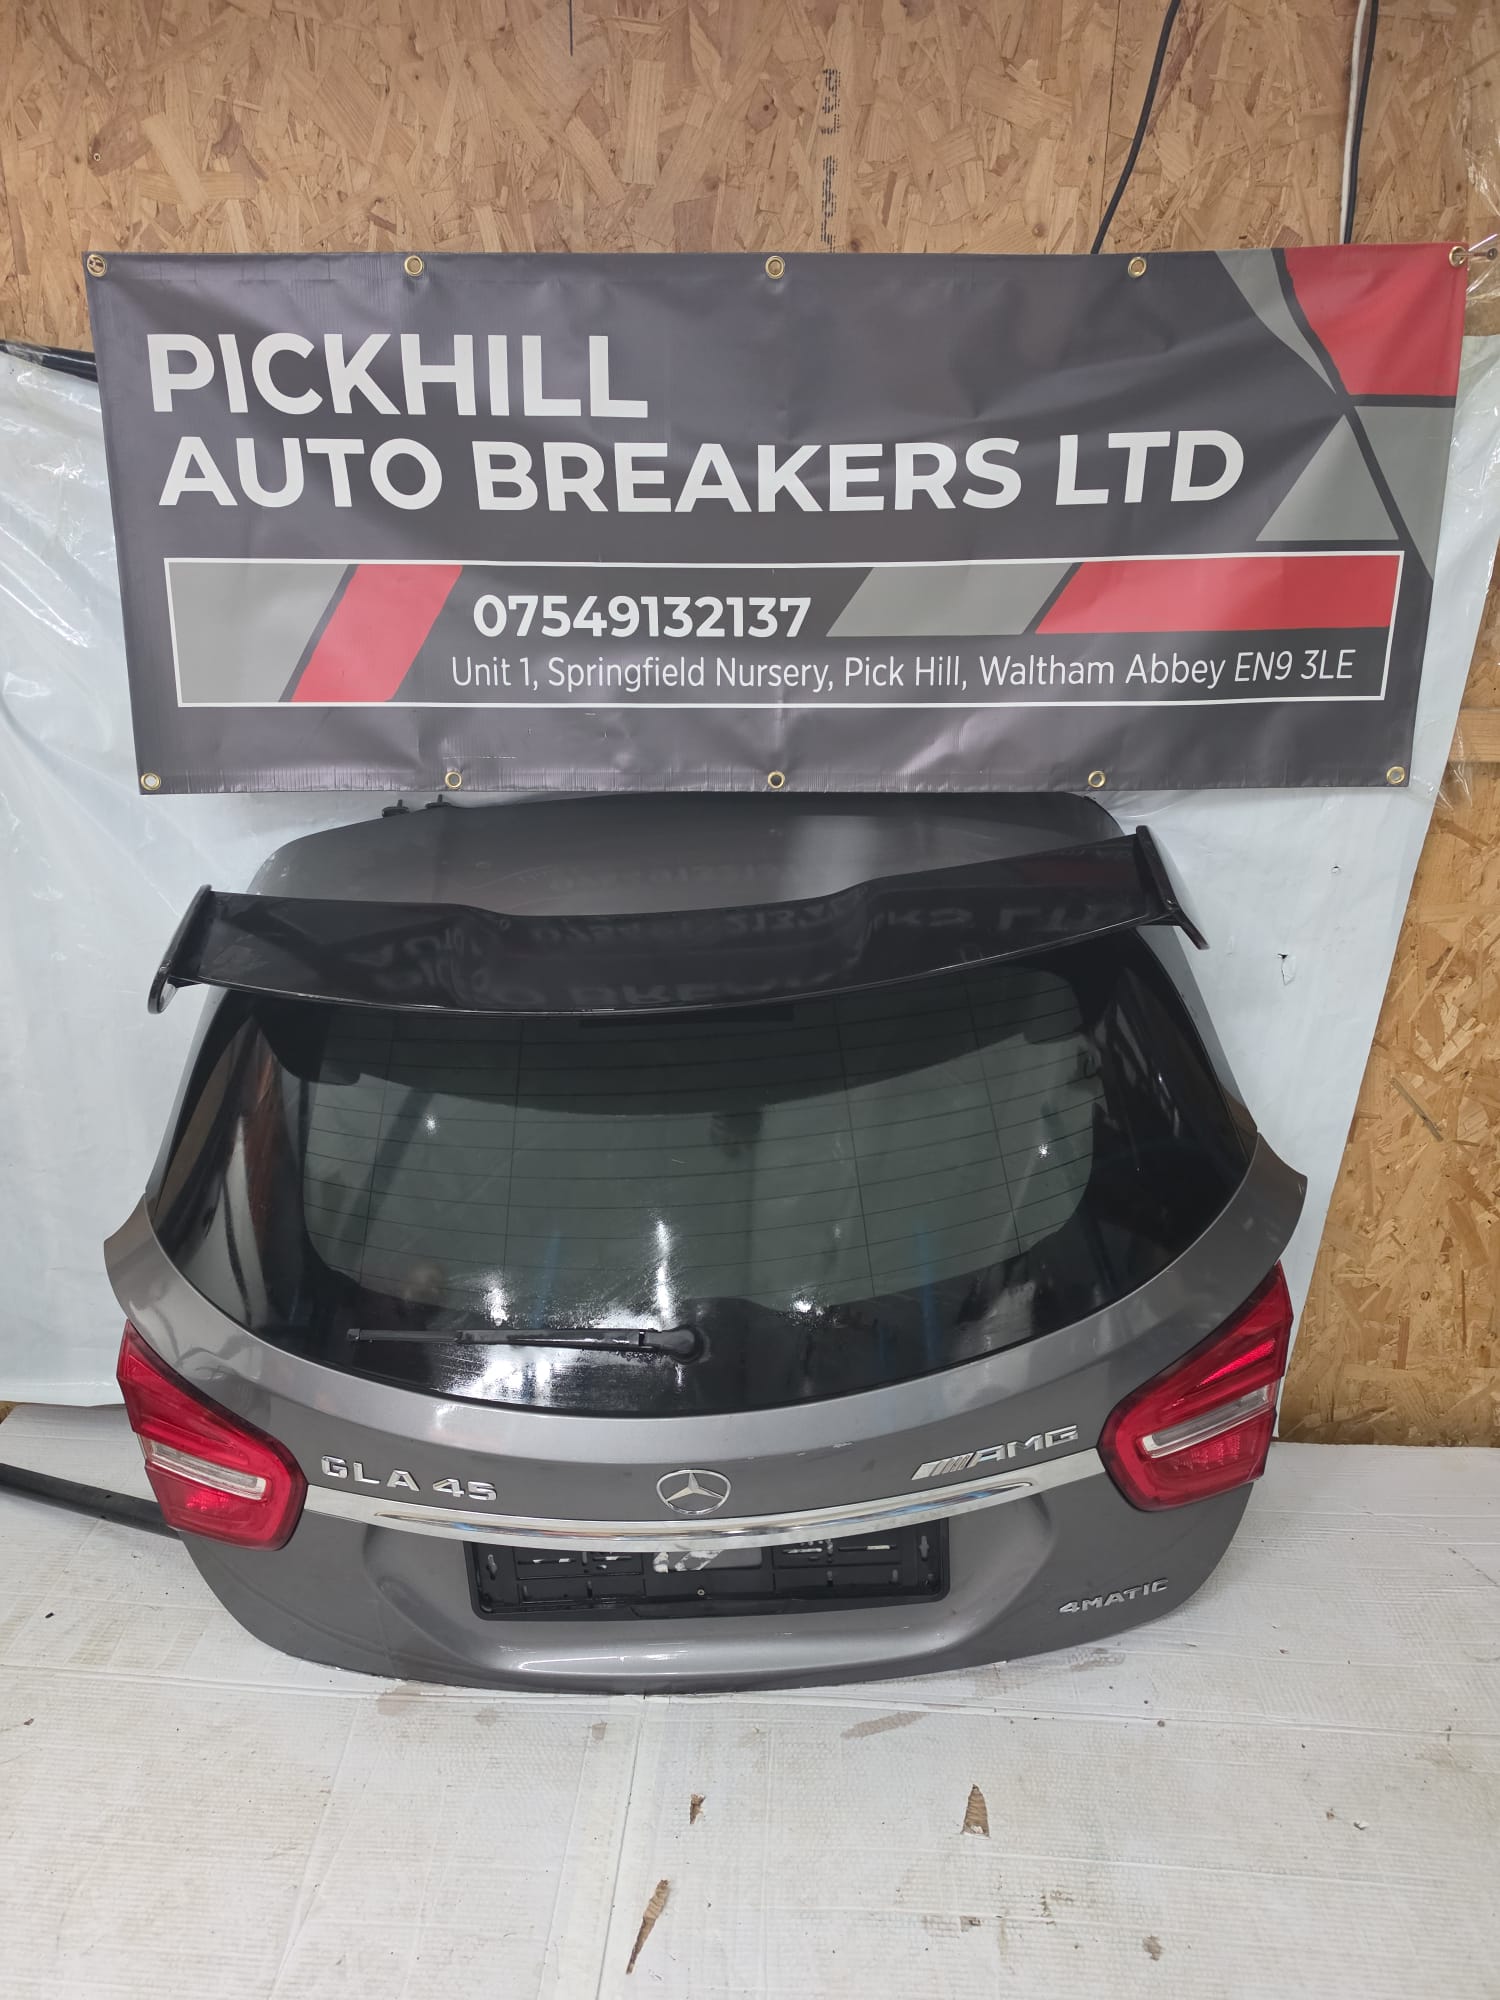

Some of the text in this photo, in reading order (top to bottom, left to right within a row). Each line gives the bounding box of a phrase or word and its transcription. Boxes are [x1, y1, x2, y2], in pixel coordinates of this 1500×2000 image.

[147, 333, 648, 418] PICKHILL
[159, 431, 1243, 512] AUTO BREAKERS LTD
[474, 595, 810, 637] 07549132137
[453, 650, 1355, 693] Unit 1, Springfield Nursery, Pick Hill, Waltham Abbey EN9 3LE
[321, 1455, 497, 1501] GLA 45
[1059, 1578, 1169, 1614] 4MATIC
